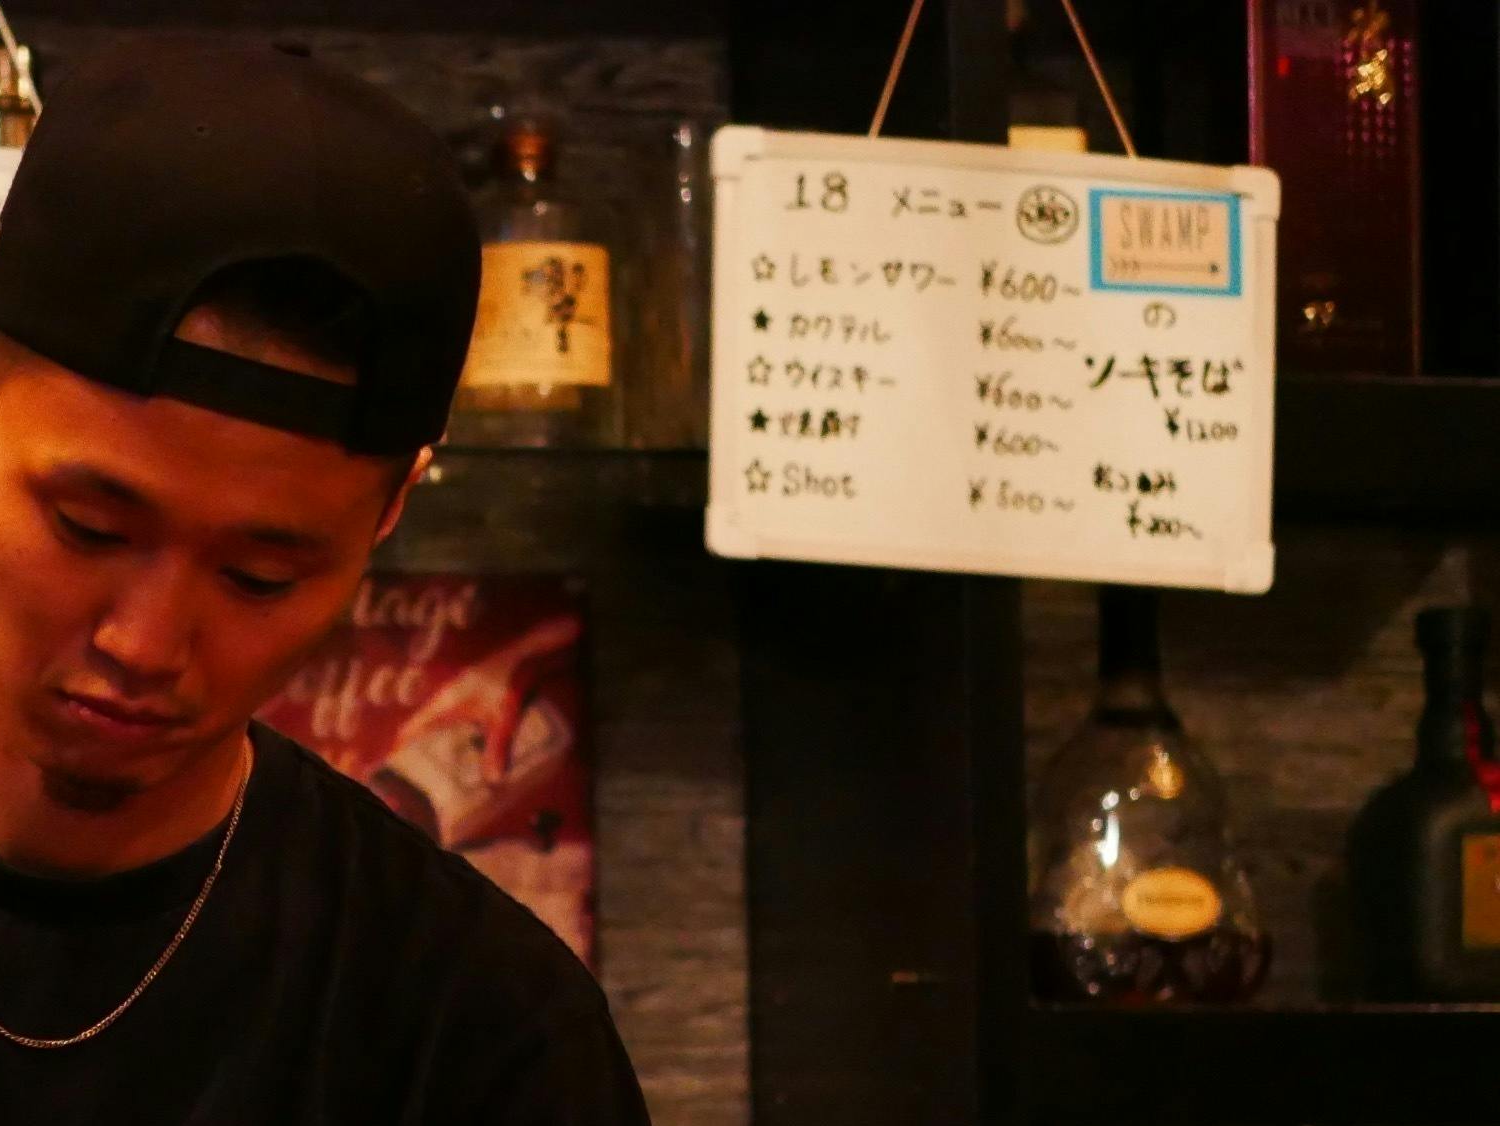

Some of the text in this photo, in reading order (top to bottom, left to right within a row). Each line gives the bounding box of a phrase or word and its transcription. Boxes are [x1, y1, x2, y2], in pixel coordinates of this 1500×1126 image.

[785, 170, 850, 214] 18
[891, 185, 1003, 218] メニュー
[1120, 201, 1211, 252] SWAMP
[1143, 301, 1178, 329] の
[1085, 353, 1245, 400] ソーキそば
[782, 462, 857, 498] Shot
